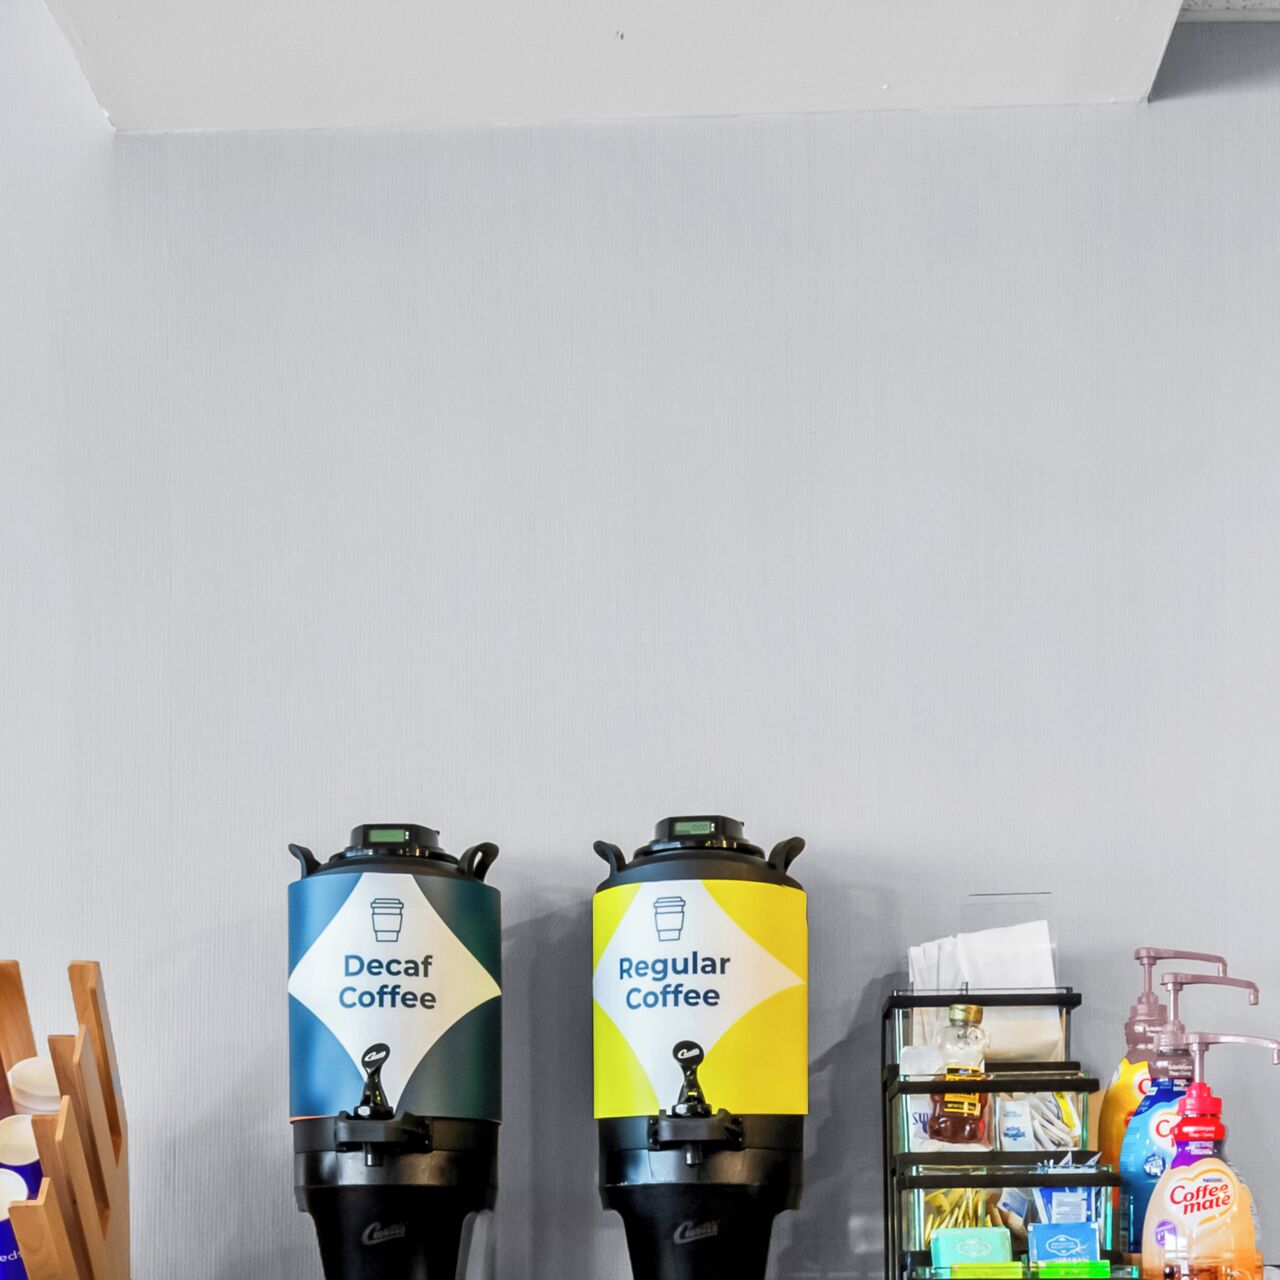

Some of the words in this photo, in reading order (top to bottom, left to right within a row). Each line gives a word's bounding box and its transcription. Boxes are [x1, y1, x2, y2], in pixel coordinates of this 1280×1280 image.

[344, 954, 433, 978] Decaf
[618, 950, 731, 982] Regular
[338, 984, 437, 1010] Coffee
[625, 983, 721, 1010] Coffee
[1169, 1183, 1229, 1206] Coffee
[1183, 1193, 1231, 1216] mate
